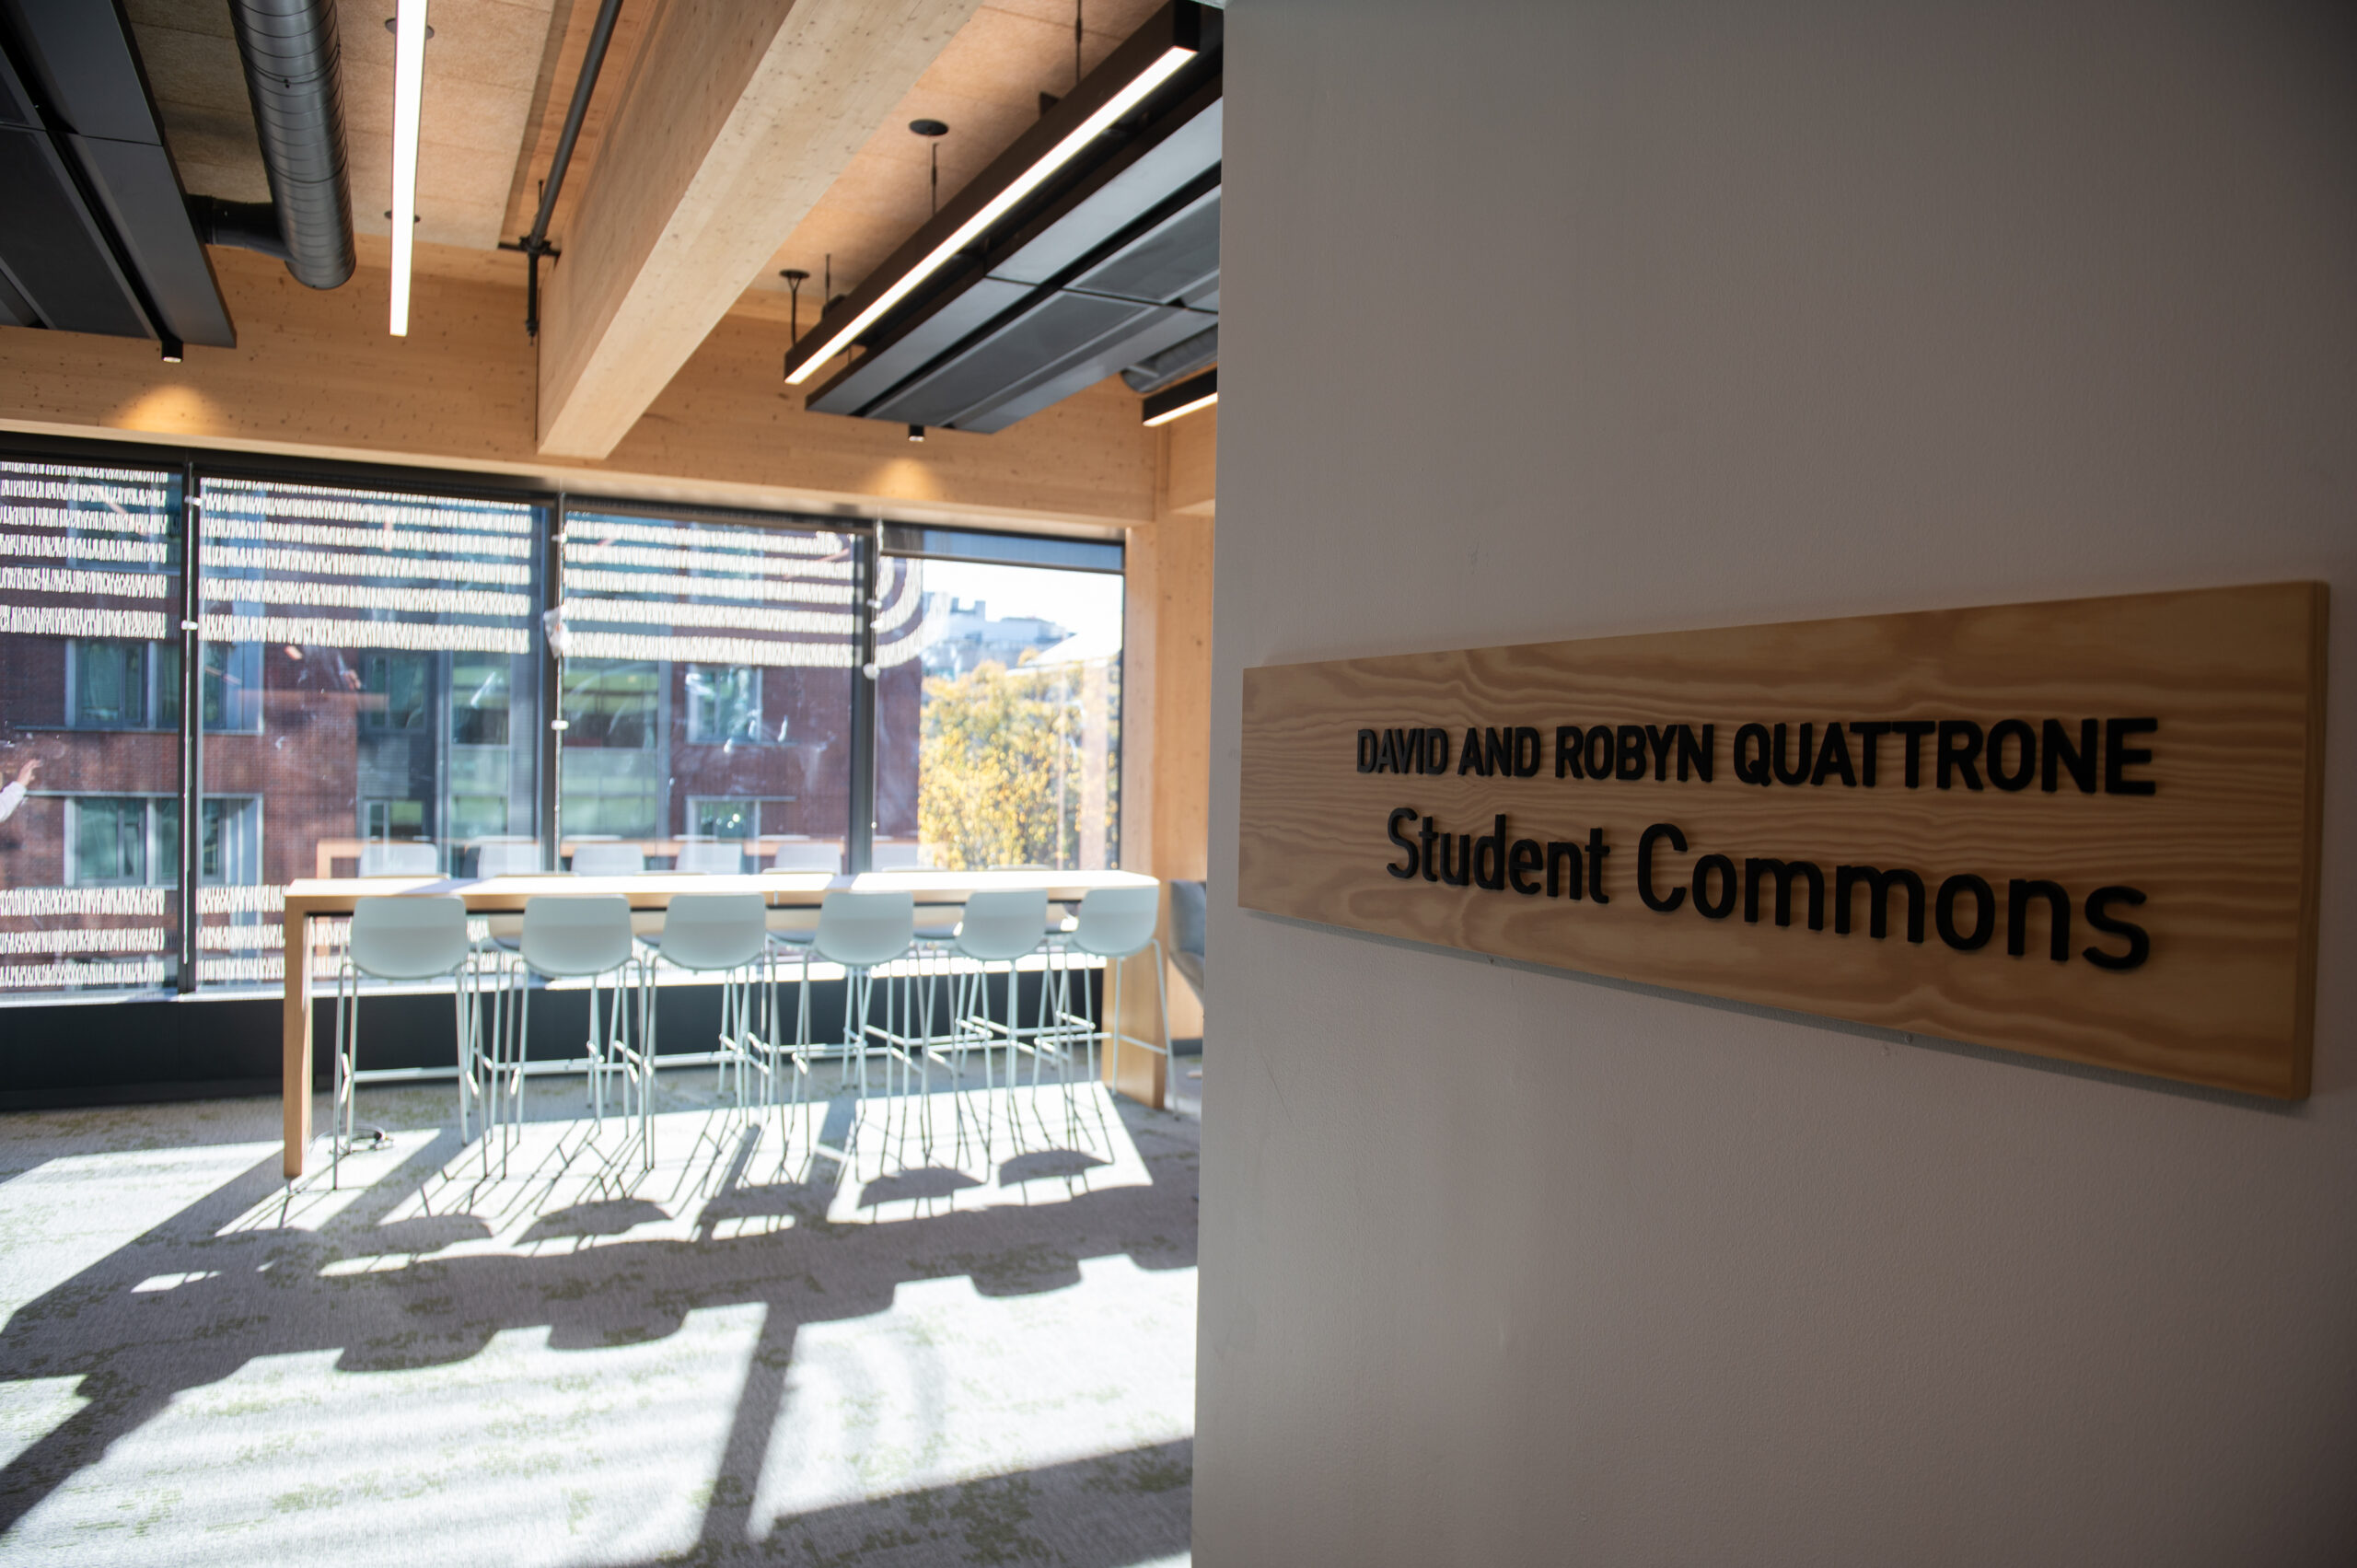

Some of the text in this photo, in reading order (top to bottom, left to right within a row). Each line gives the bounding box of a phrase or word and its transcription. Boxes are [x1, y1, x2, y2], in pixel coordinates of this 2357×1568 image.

[1356, 717, 2159, 796] DAVID AND ROBYN QUATTRONE
[1387, 807, 2151, 970] Student Commons
